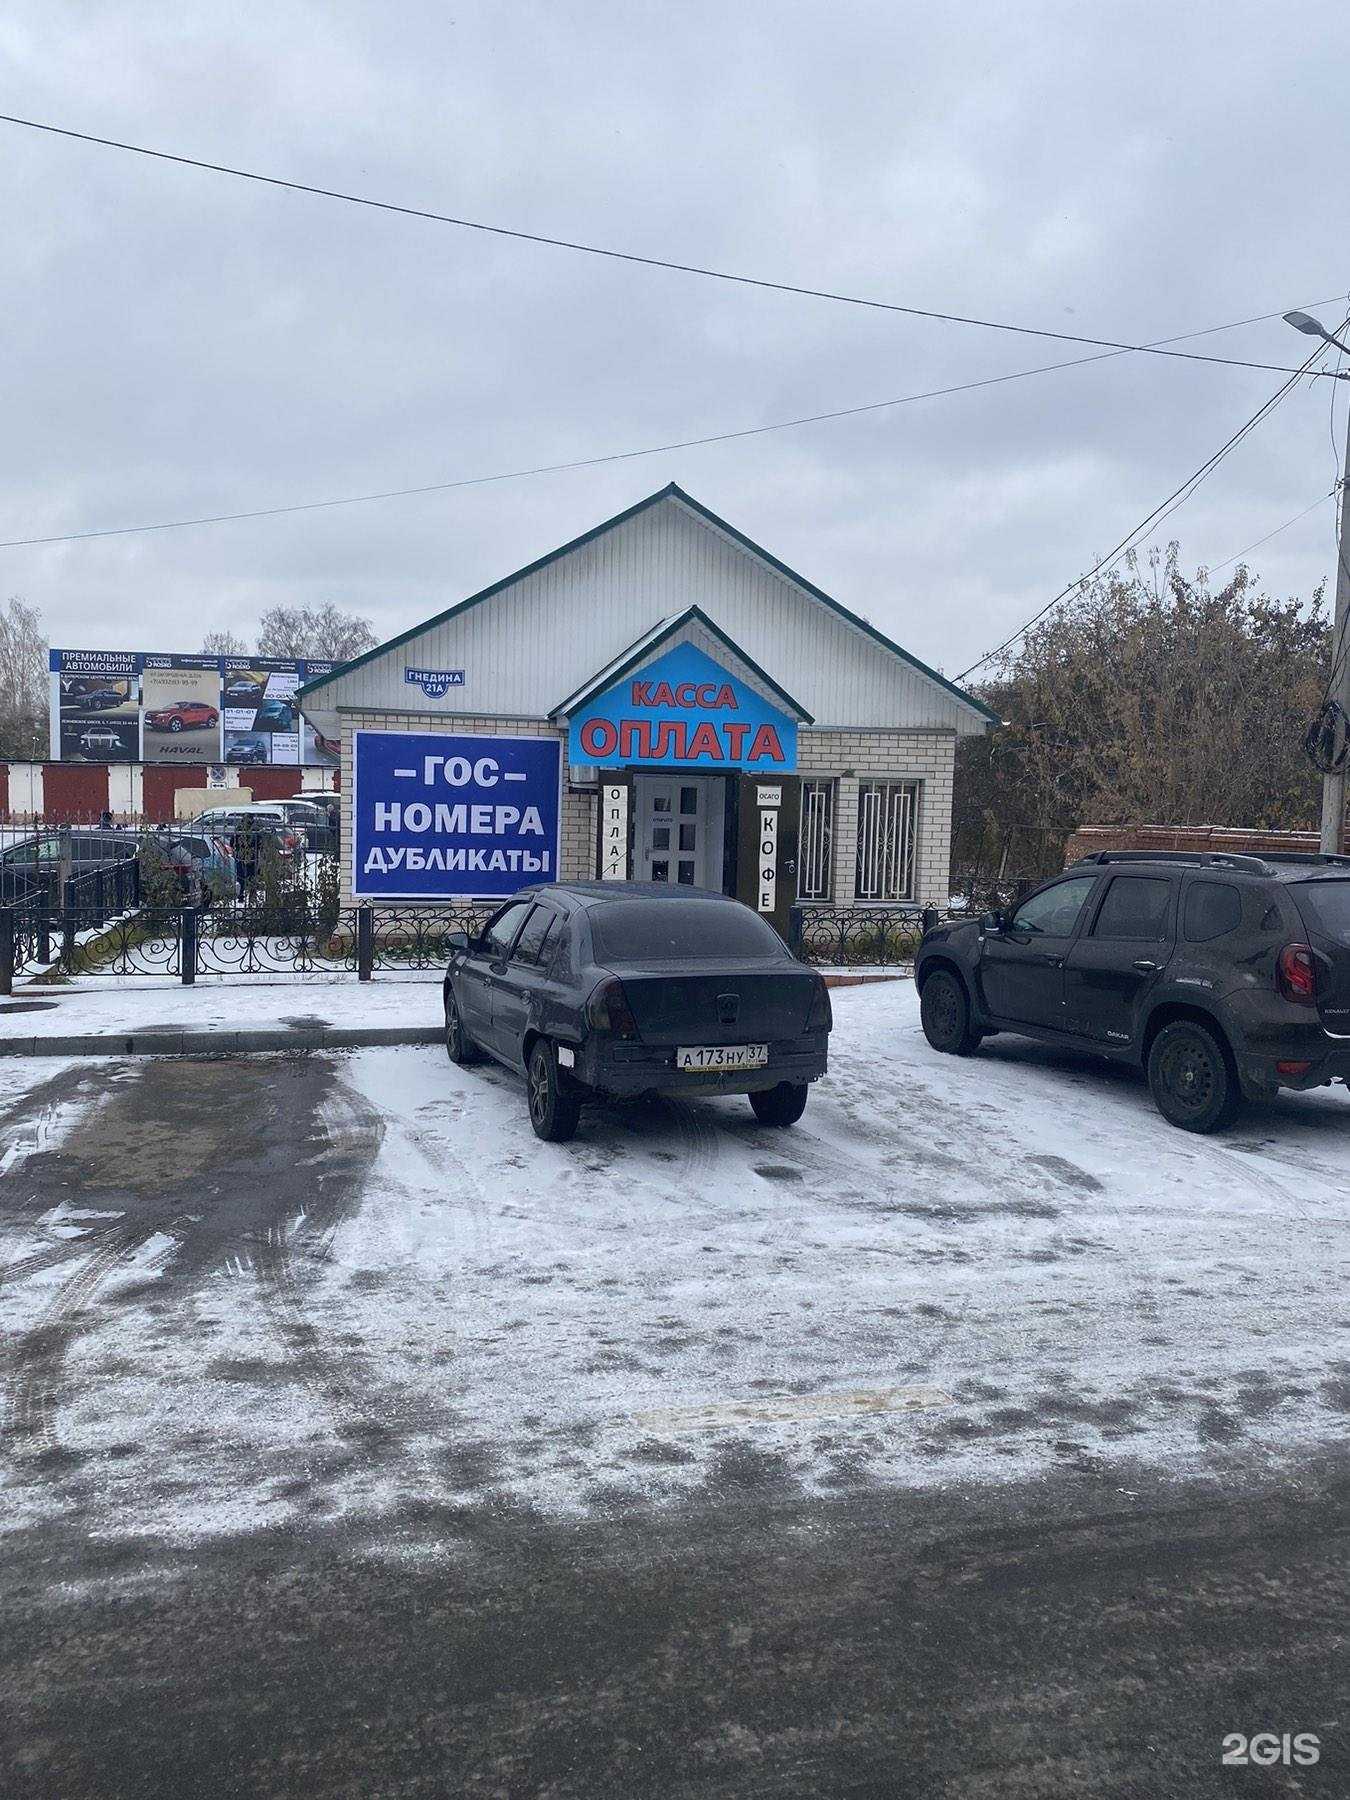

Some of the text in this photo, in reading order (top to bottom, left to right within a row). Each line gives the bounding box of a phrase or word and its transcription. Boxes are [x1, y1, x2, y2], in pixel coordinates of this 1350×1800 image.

[62, 652, 137, 663] ПРЕМИАЛЬНЫЕ
[65, 662, 133, 672] АВТОМОБИЛИ
[408, 671, 462, 684] ГНЕДИНА
[426, 682, 443, 694] 21А
[631, 681, 738, 710] КАССА
[580, 718, 786, 762] ОПЛАТА
[159, 745, 204, 754] HAVAL
[759, 792, 780, 801] ОСАГО
[374, 802, 545, 836] НОМЕРА
[610, 789, 620, 875] ОПЛАТ
[364, 846, 550, 875] ДУБЛИКАТЫ
[761, 817, 775, 907] КОФЕ
[748, 1046, 763, 1059] 37
